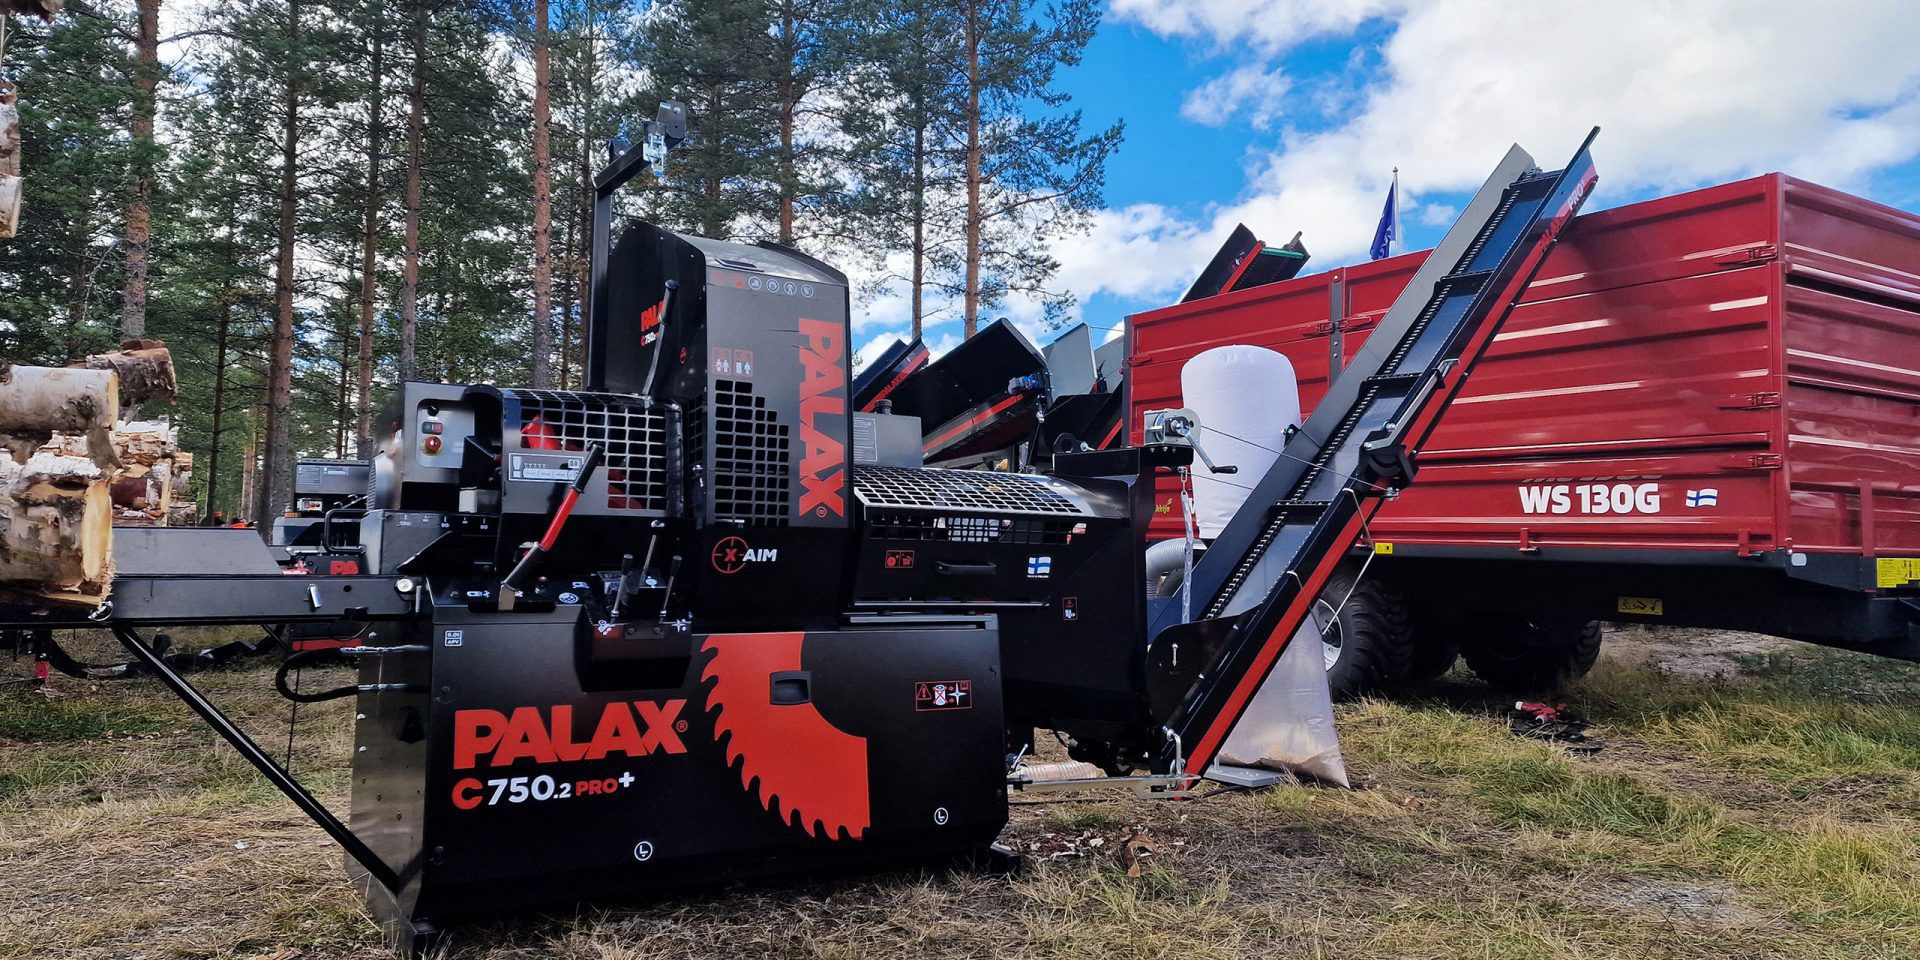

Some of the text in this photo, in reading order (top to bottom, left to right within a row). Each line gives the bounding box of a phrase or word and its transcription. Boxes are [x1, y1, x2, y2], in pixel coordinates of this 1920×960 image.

[1518, 483, 1660, 514] WS 130G
[742, 548, 778, 562] AIM
[575, 771, 635, 797] PRO+
